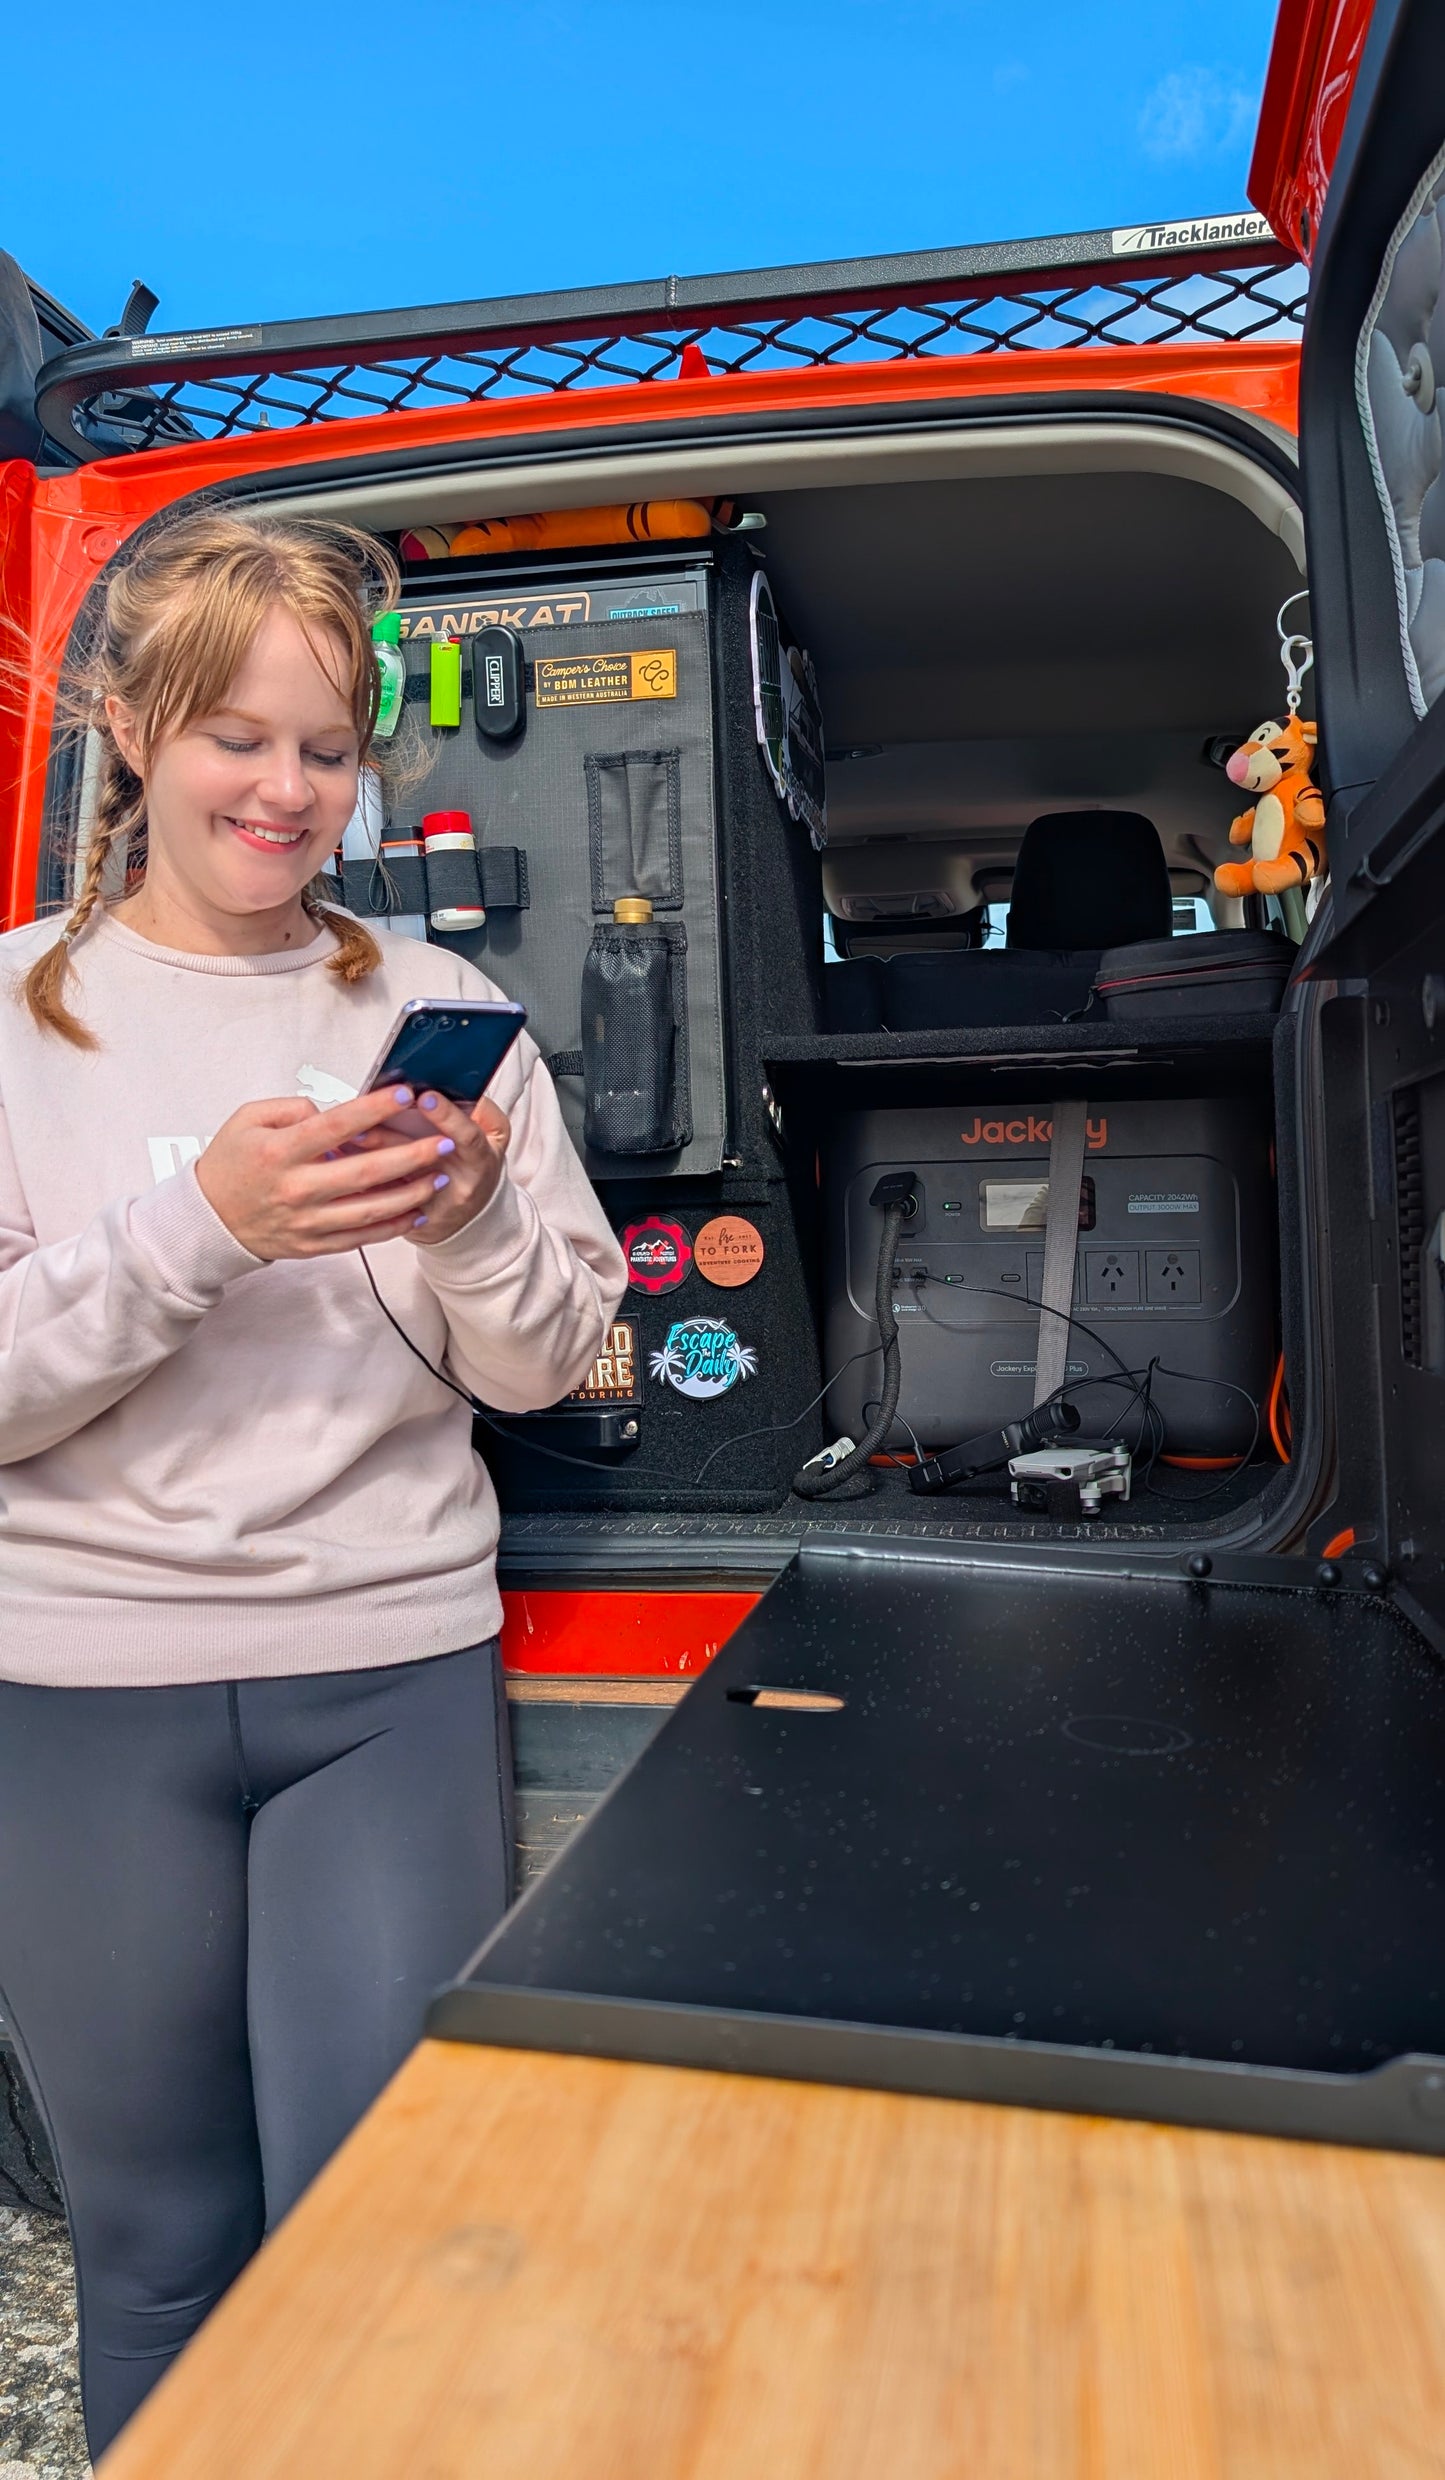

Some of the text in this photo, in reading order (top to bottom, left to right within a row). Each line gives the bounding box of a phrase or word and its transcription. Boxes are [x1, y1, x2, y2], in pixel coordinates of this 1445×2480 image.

[1145, 219, 1267, 247] Tracklander
[541, 658, 628, 679] Camper's Choice
[489, 660, 501, 702] CLIPPER
[554, 679, 577, 690] BDM
[581, 675, 628, 688] LEATHER
[567, 692, 594, 700] WESTERN
[595, 689, 628, 698] AUSTRALIA
[961, 1116, 1107, 1148] Jacky
[1167, 1193, 1199, 1201] 2042Wh
[700, 1244, 757, 1256] TO FORK
[667, 1324, 735, 1358] Escape
[684, 1348, 737, 1387] Daily
[996, 1365, 1021, 1373] Jackery
[570, 1389, 633, 1400] TOURING
